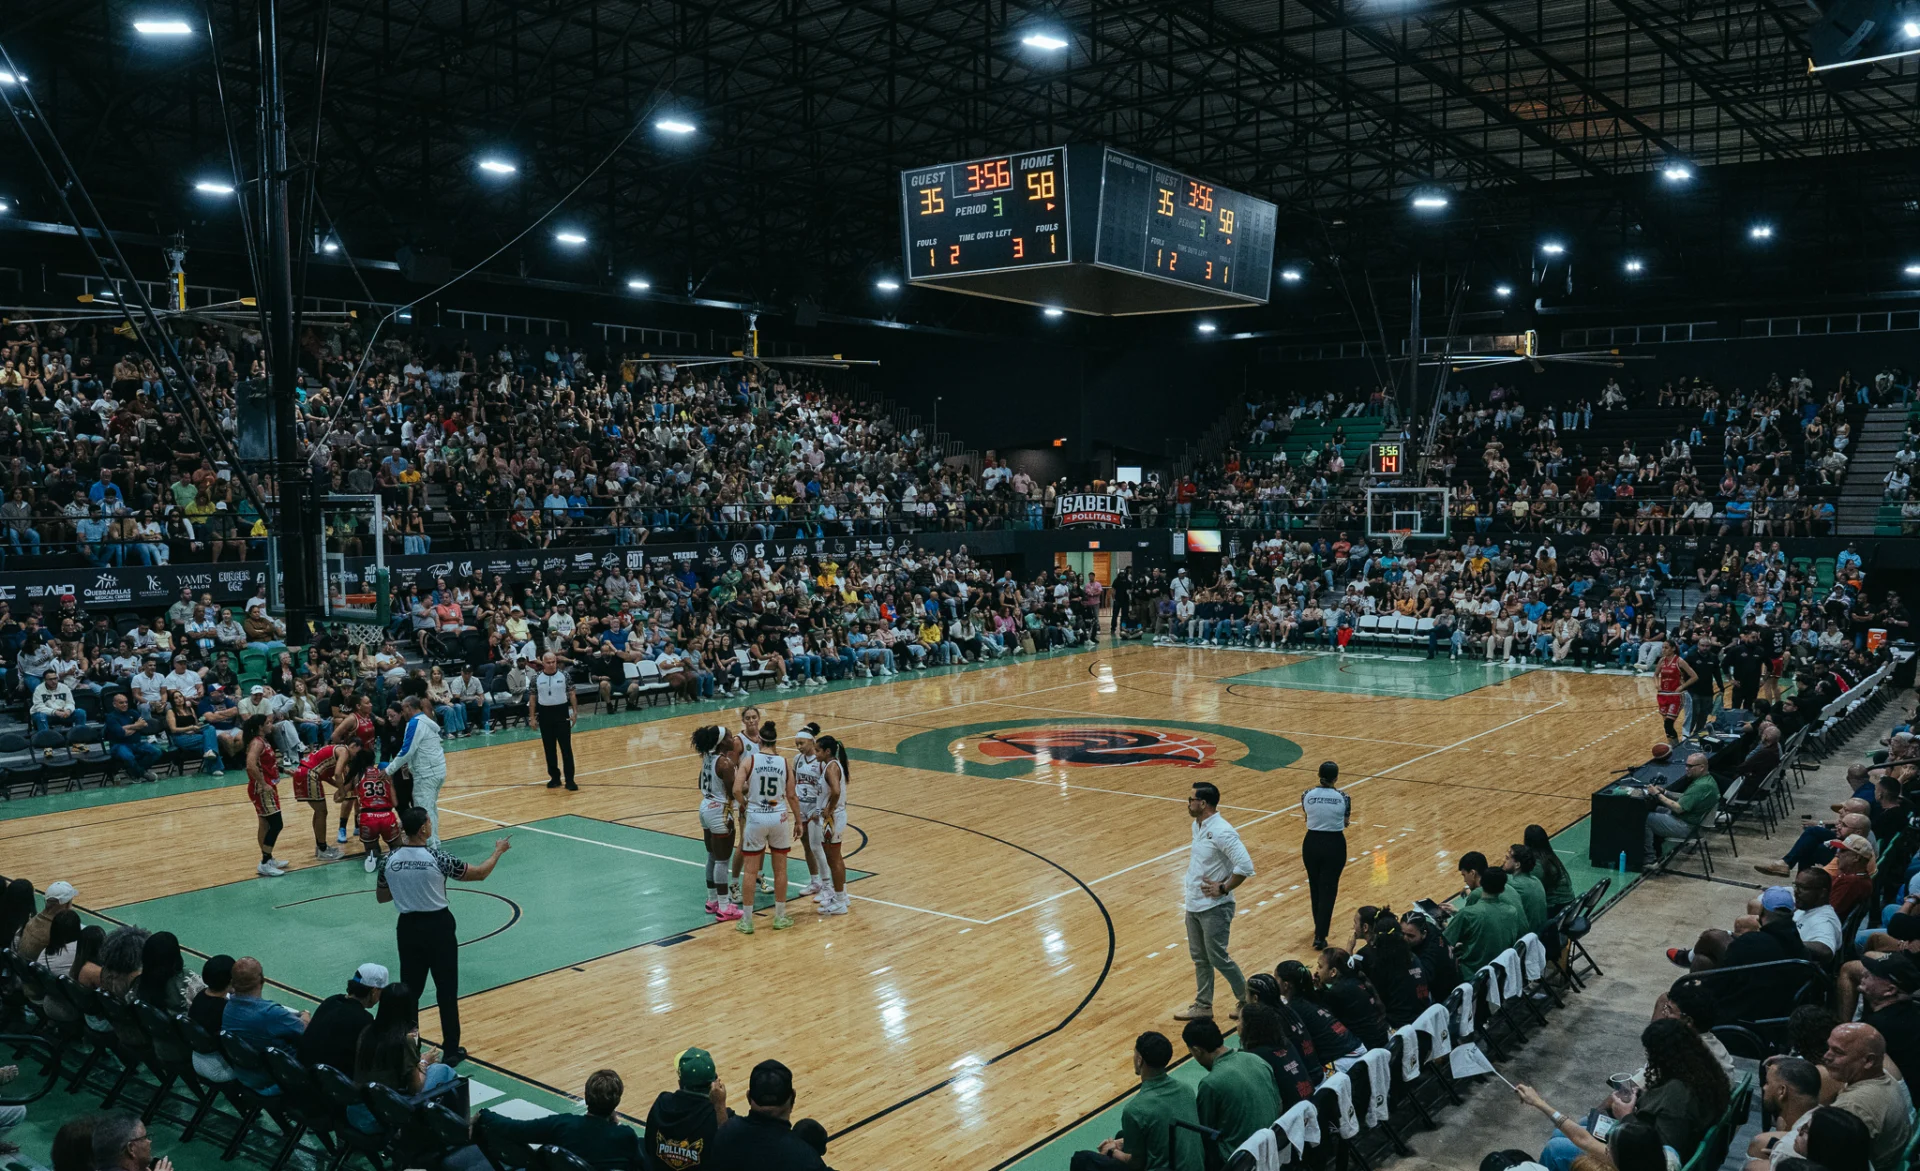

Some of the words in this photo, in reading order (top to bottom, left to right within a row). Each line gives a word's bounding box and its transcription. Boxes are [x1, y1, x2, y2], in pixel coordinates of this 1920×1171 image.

[1020, 154, 1055, 170] HOME
[911, 171, 945, 187] GUEST
[967, 160, 1010, 192] 3:56
[1156, 172, 1178, 187] GUEST
[1027, 171, 1055, 200] 58
[919, 187, 945, 215] 35
[1157, 188, 1174, 217] 35
[1188, 181, 1214, 213] 3:56
[955, 204, 987, 217] PERIOD
[993, 197, 1003, 217] 3
[1035, 223, 1059, 233] FOULS
[1199, 219, 1206, 238] 3
[1219, 207, 1234, 235] 58
[916, 238, 938, 247] FOULS
[959, 233, 975, 242] TIME
[977, 231, 994, 240] OUTS
[996, 229, 1012, 238] LEFT
[1151, 237, 1165, 247] FOULS
[950, 245, 960, 265] 2
[1012, 237, 1024, 258] 3
[1169, 252, 1177, 271] 2
[1205, 261, 1213, 280] 3
[1379, 445, 1399, 456] 3:56
[1382, 456, 1396, 472] 14
[1056, 495, 1127, 516] ISABELA
[1071, 513, 1112, 522] POLLITAS
[626, 552, 644, 568] CDT
[176, 573, 212, 585] YAMI'S
[218, 570, 251, 583] BURGER
[83, 588, 132, 597] QUEBRADILLAS
[363, 780, 387, 798] 33
[759, 776, 778, 796] 15
[803, 788, 808, 797] 3
[403, 860, 434, 868] FERRIES
[658, 1143, 698, 1162] POLLITAS
